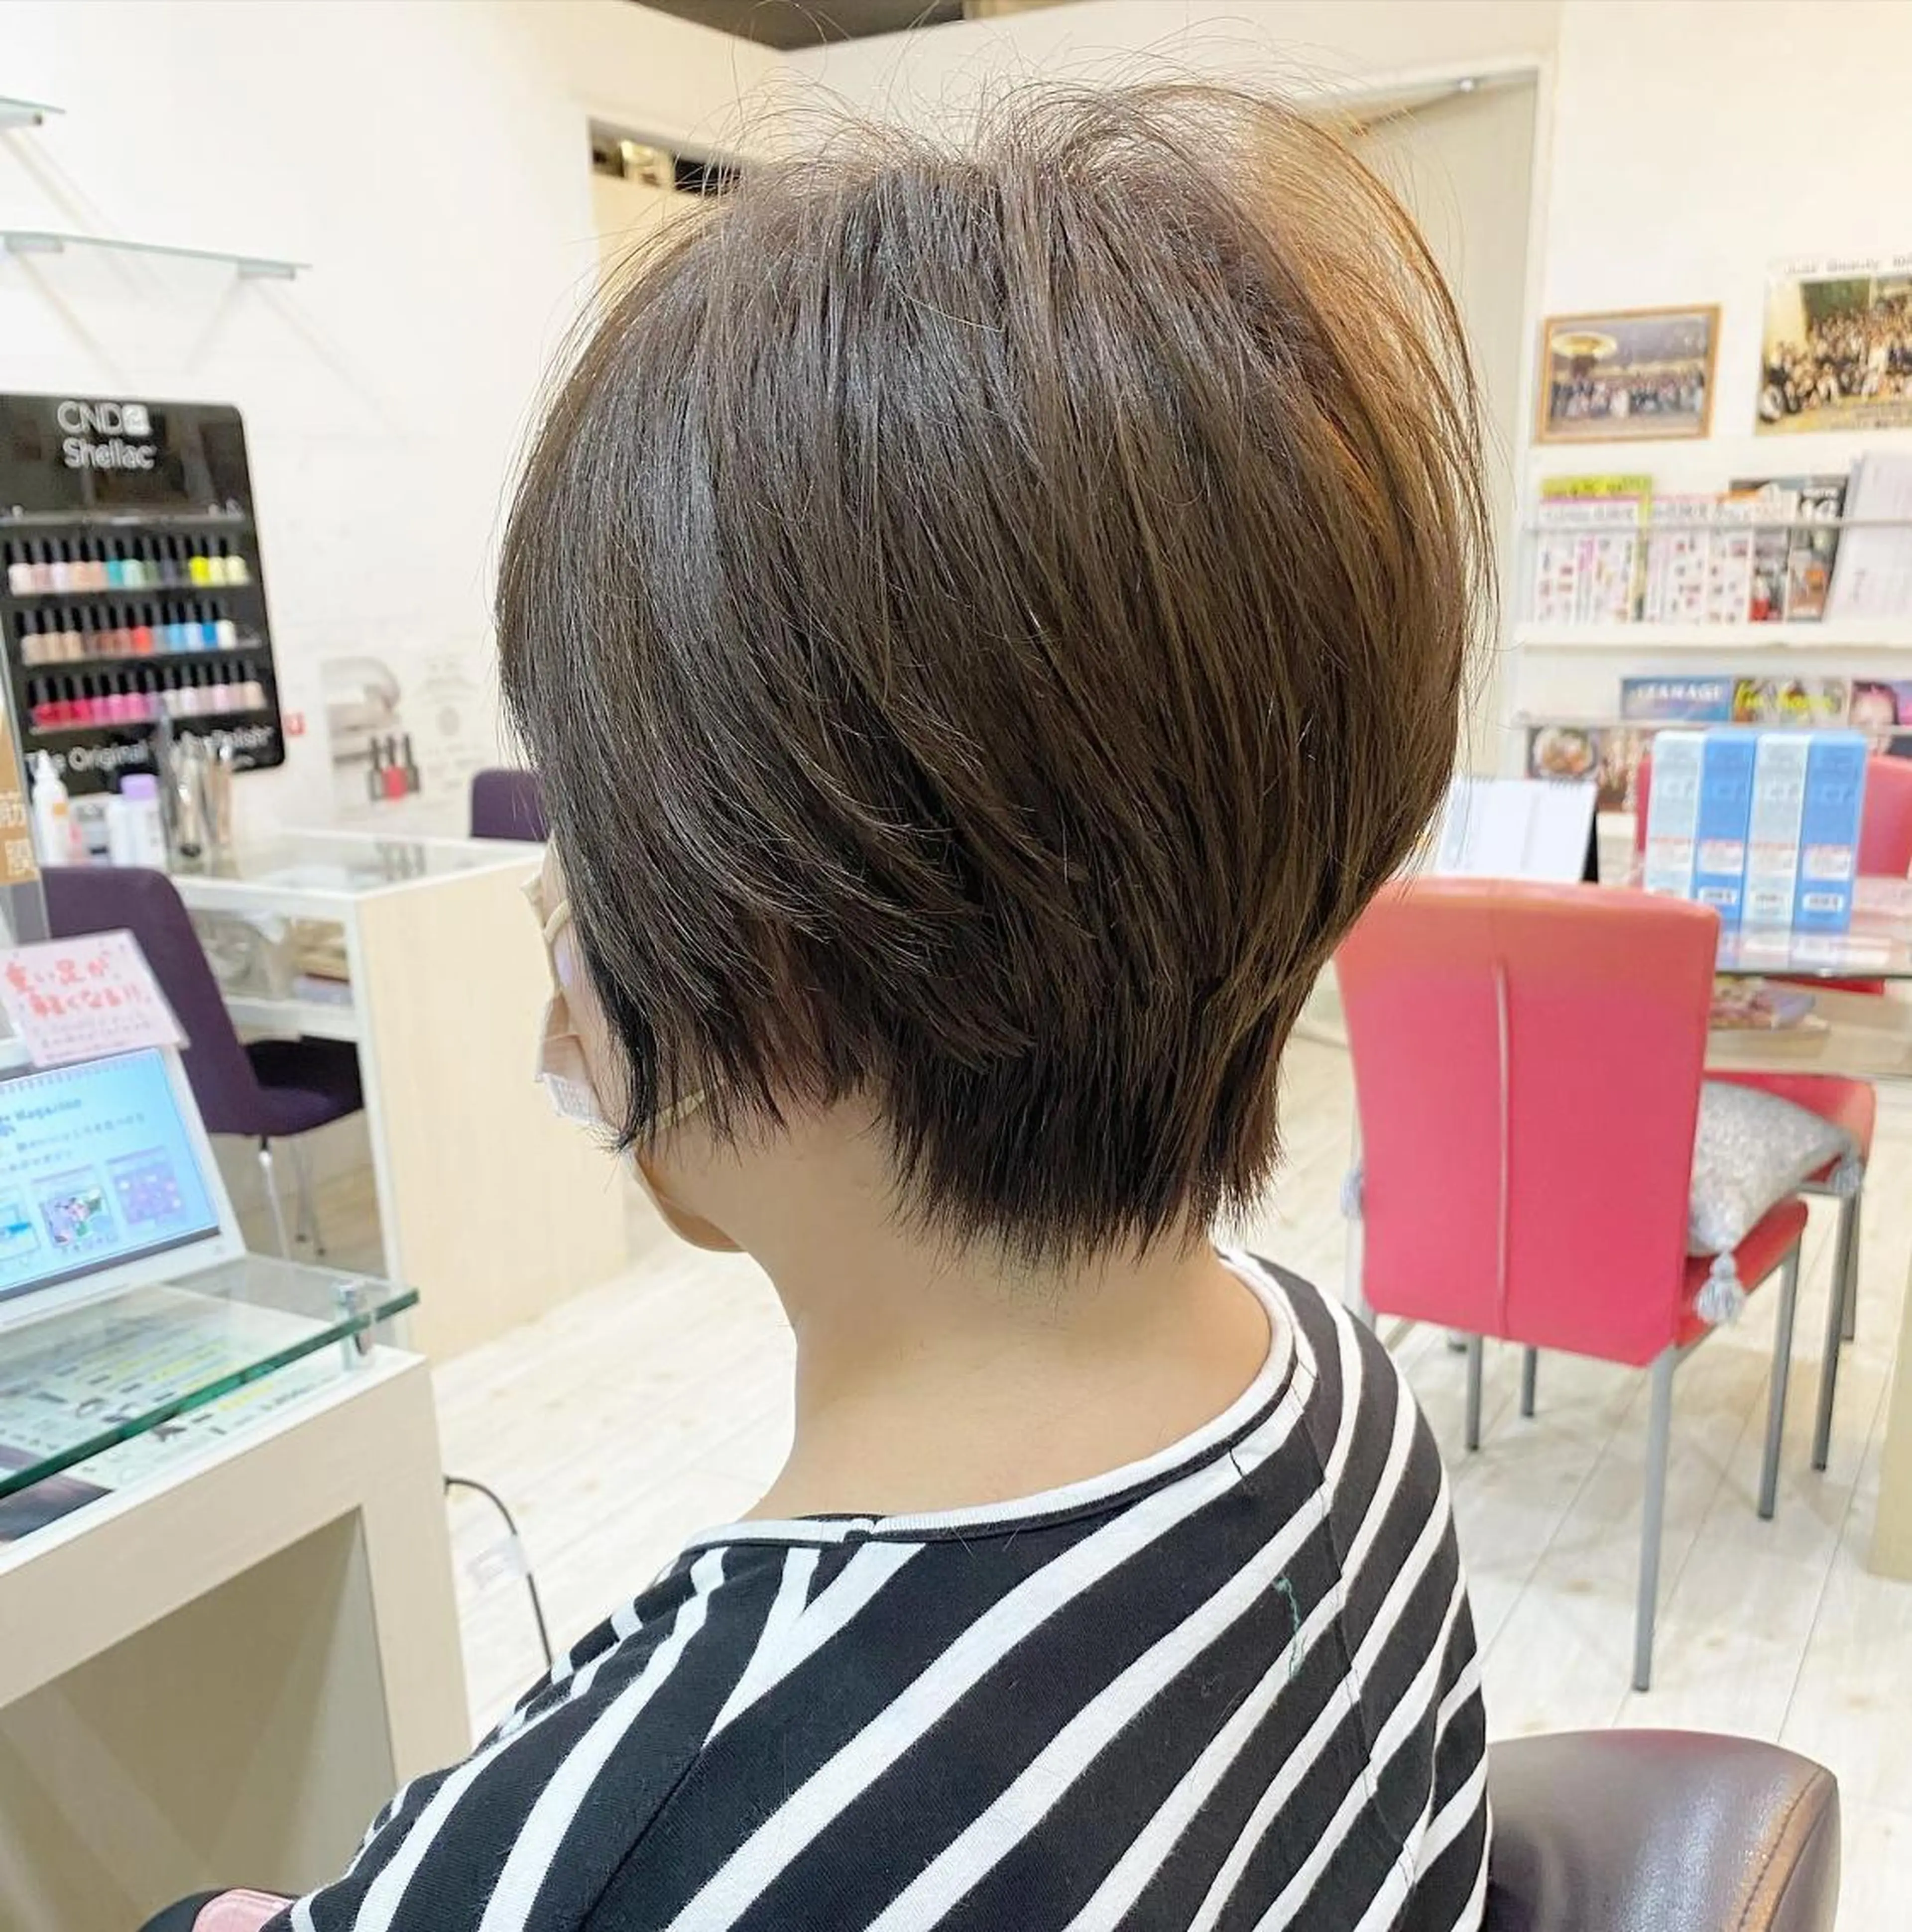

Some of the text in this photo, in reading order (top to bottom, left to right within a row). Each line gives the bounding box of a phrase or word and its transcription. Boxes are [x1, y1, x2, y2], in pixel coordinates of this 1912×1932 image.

[57, 400, 122, 435] CND
[62, 437, 156, 469] Shellac
[68, 739, 150, 773] Original
